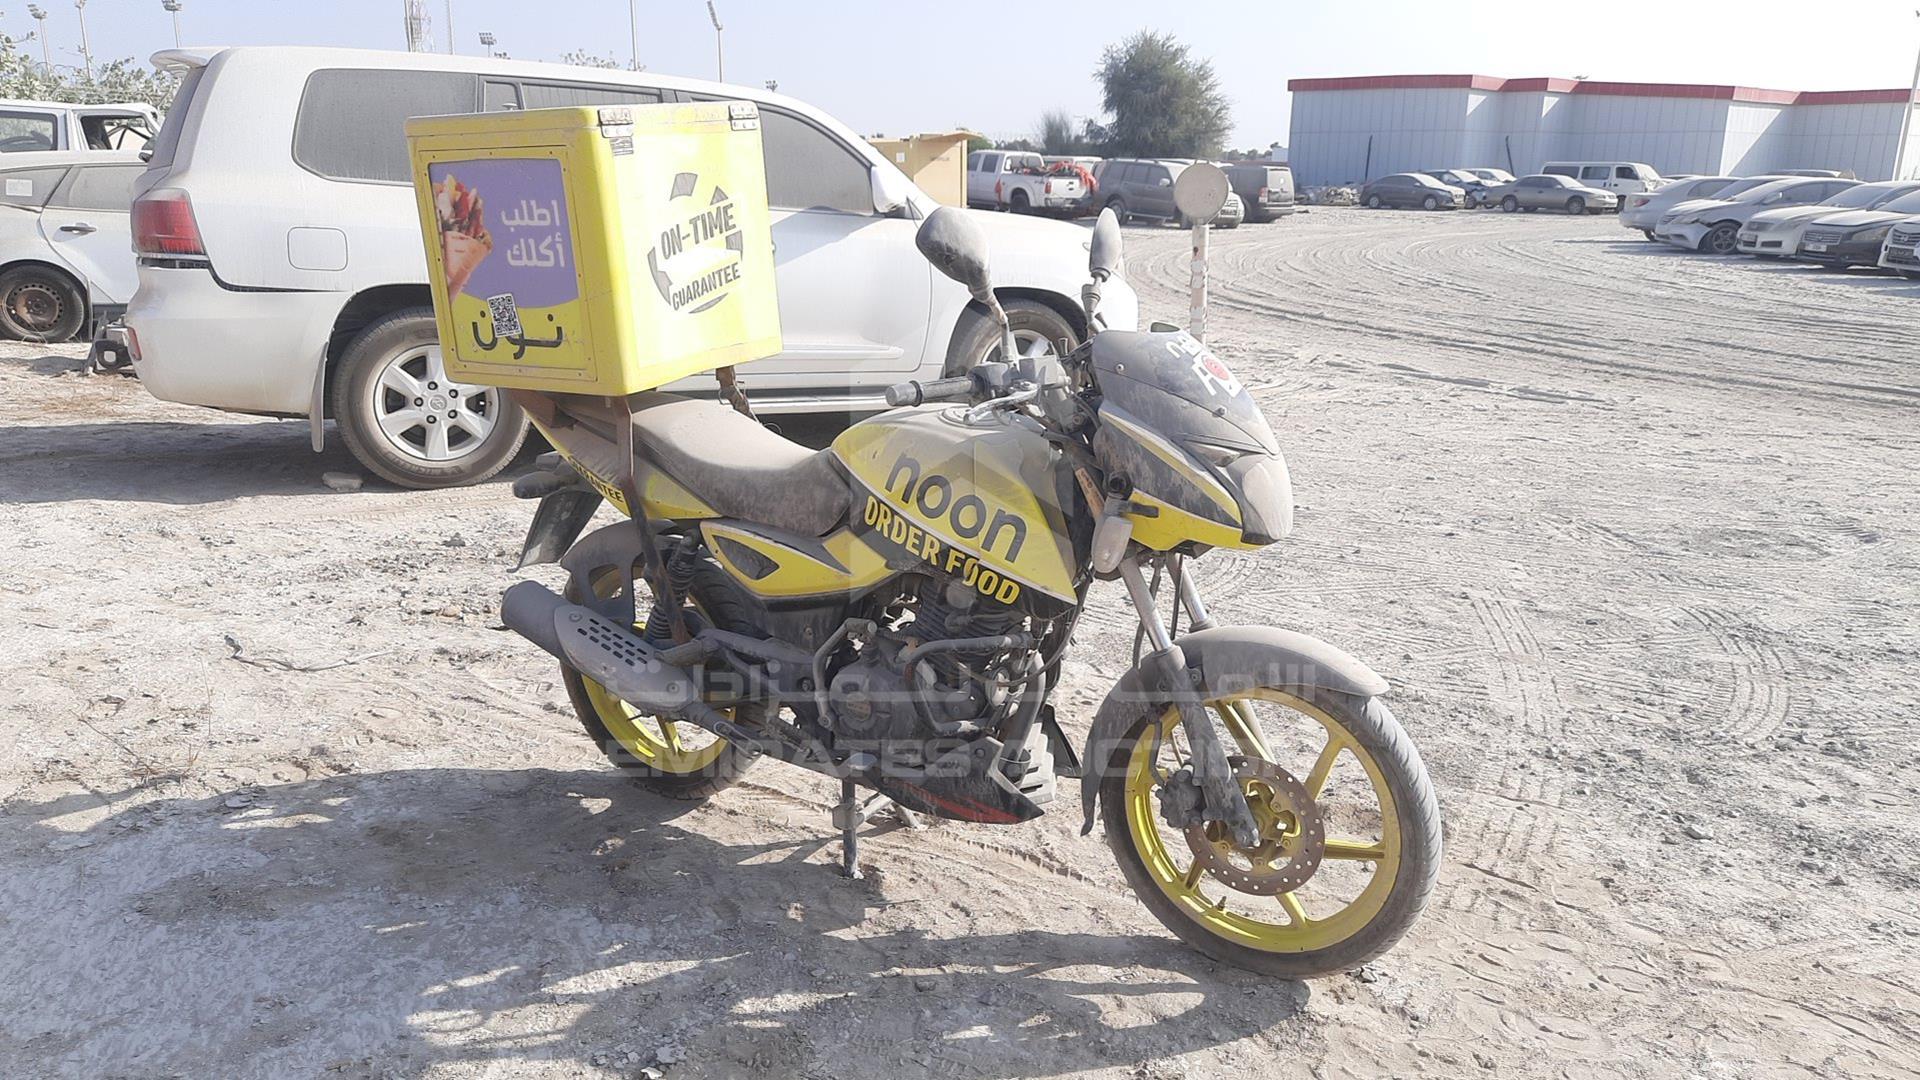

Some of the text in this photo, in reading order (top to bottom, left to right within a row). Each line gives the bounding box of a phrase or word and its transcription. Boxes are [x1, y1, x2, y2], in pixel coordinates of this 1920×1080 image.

[501, 200, 560, 232] اطلب
[660, 203, 737, 260] ON-TIME
[506, 233, 565, 268] أكلك
[671, 262, 741, 311] GUARANTEE
[884, 453, 1027, 563] noon
[864, 495, 1021, 605] ORDER FOOD
